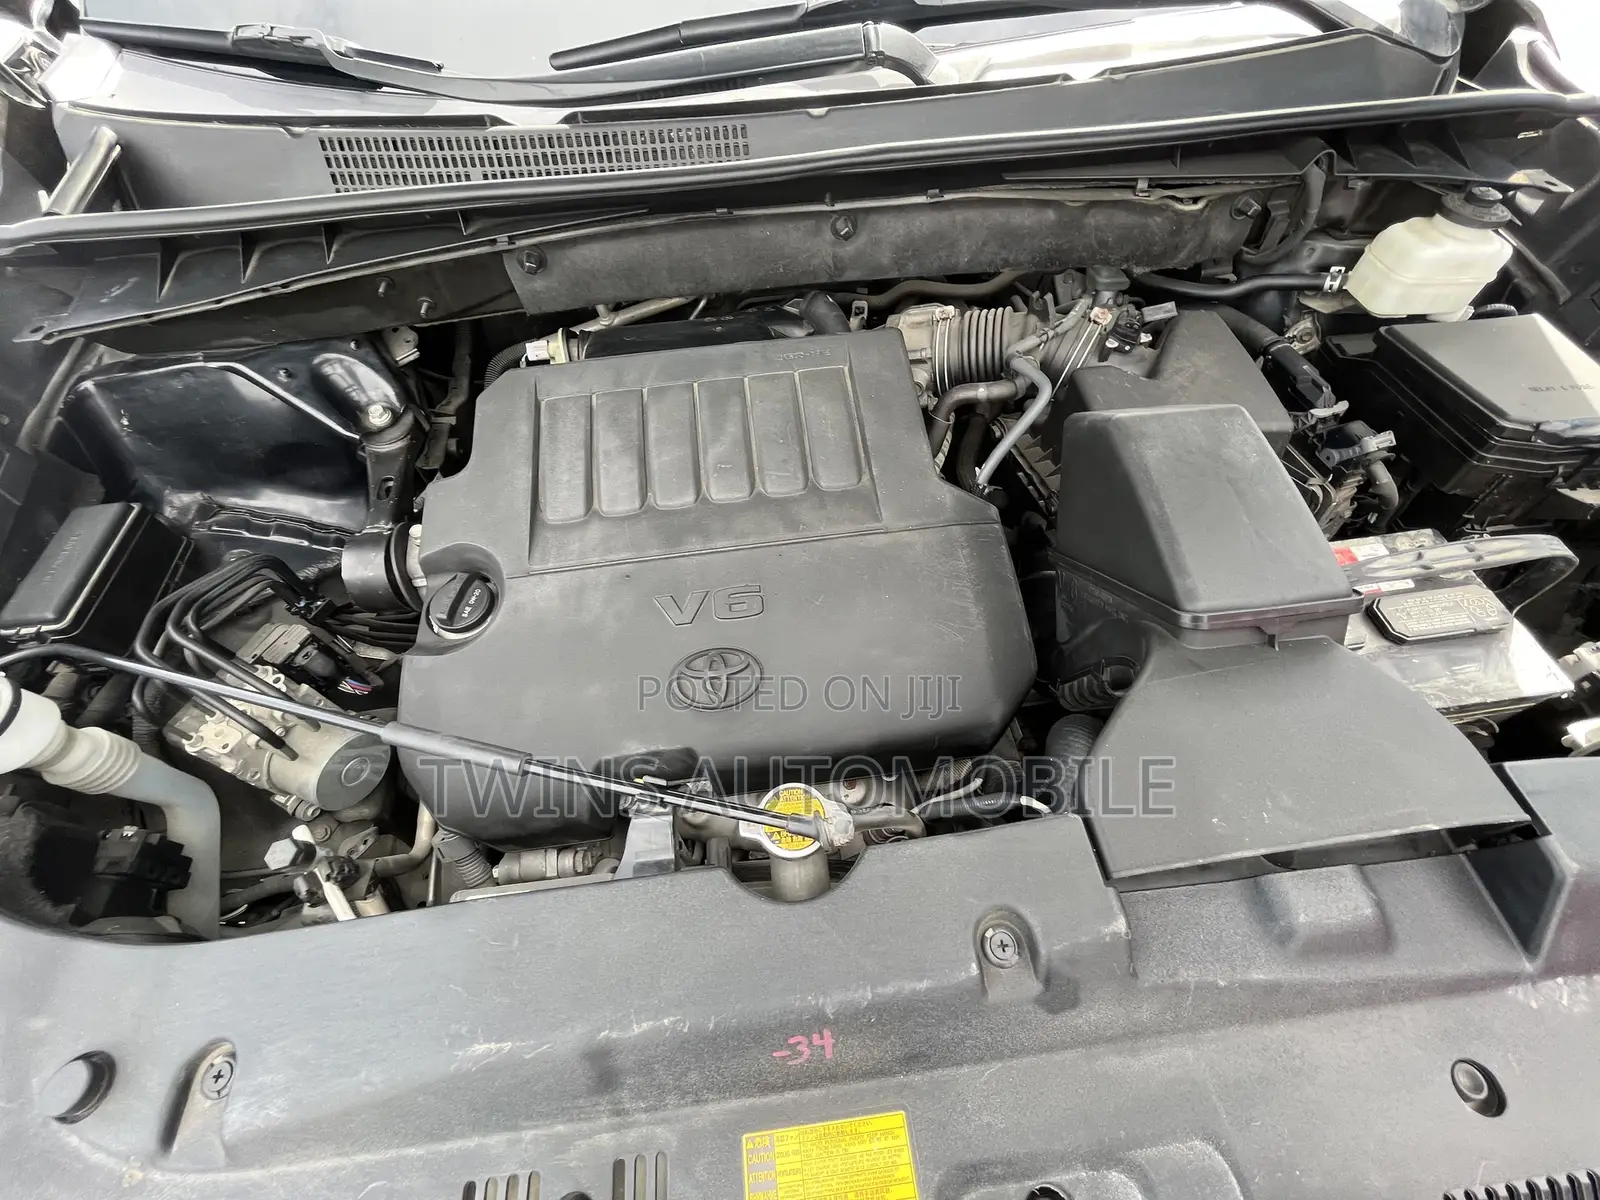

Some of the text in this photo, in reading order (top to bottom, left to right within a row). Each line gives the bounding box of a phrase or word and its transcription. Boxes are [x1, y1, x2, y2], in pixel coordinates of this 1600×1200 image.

[653, 583, 765, 627] V6
[461, 606, 473, 618] SAE
[748, 1151, 775, 1164] CAUTION
